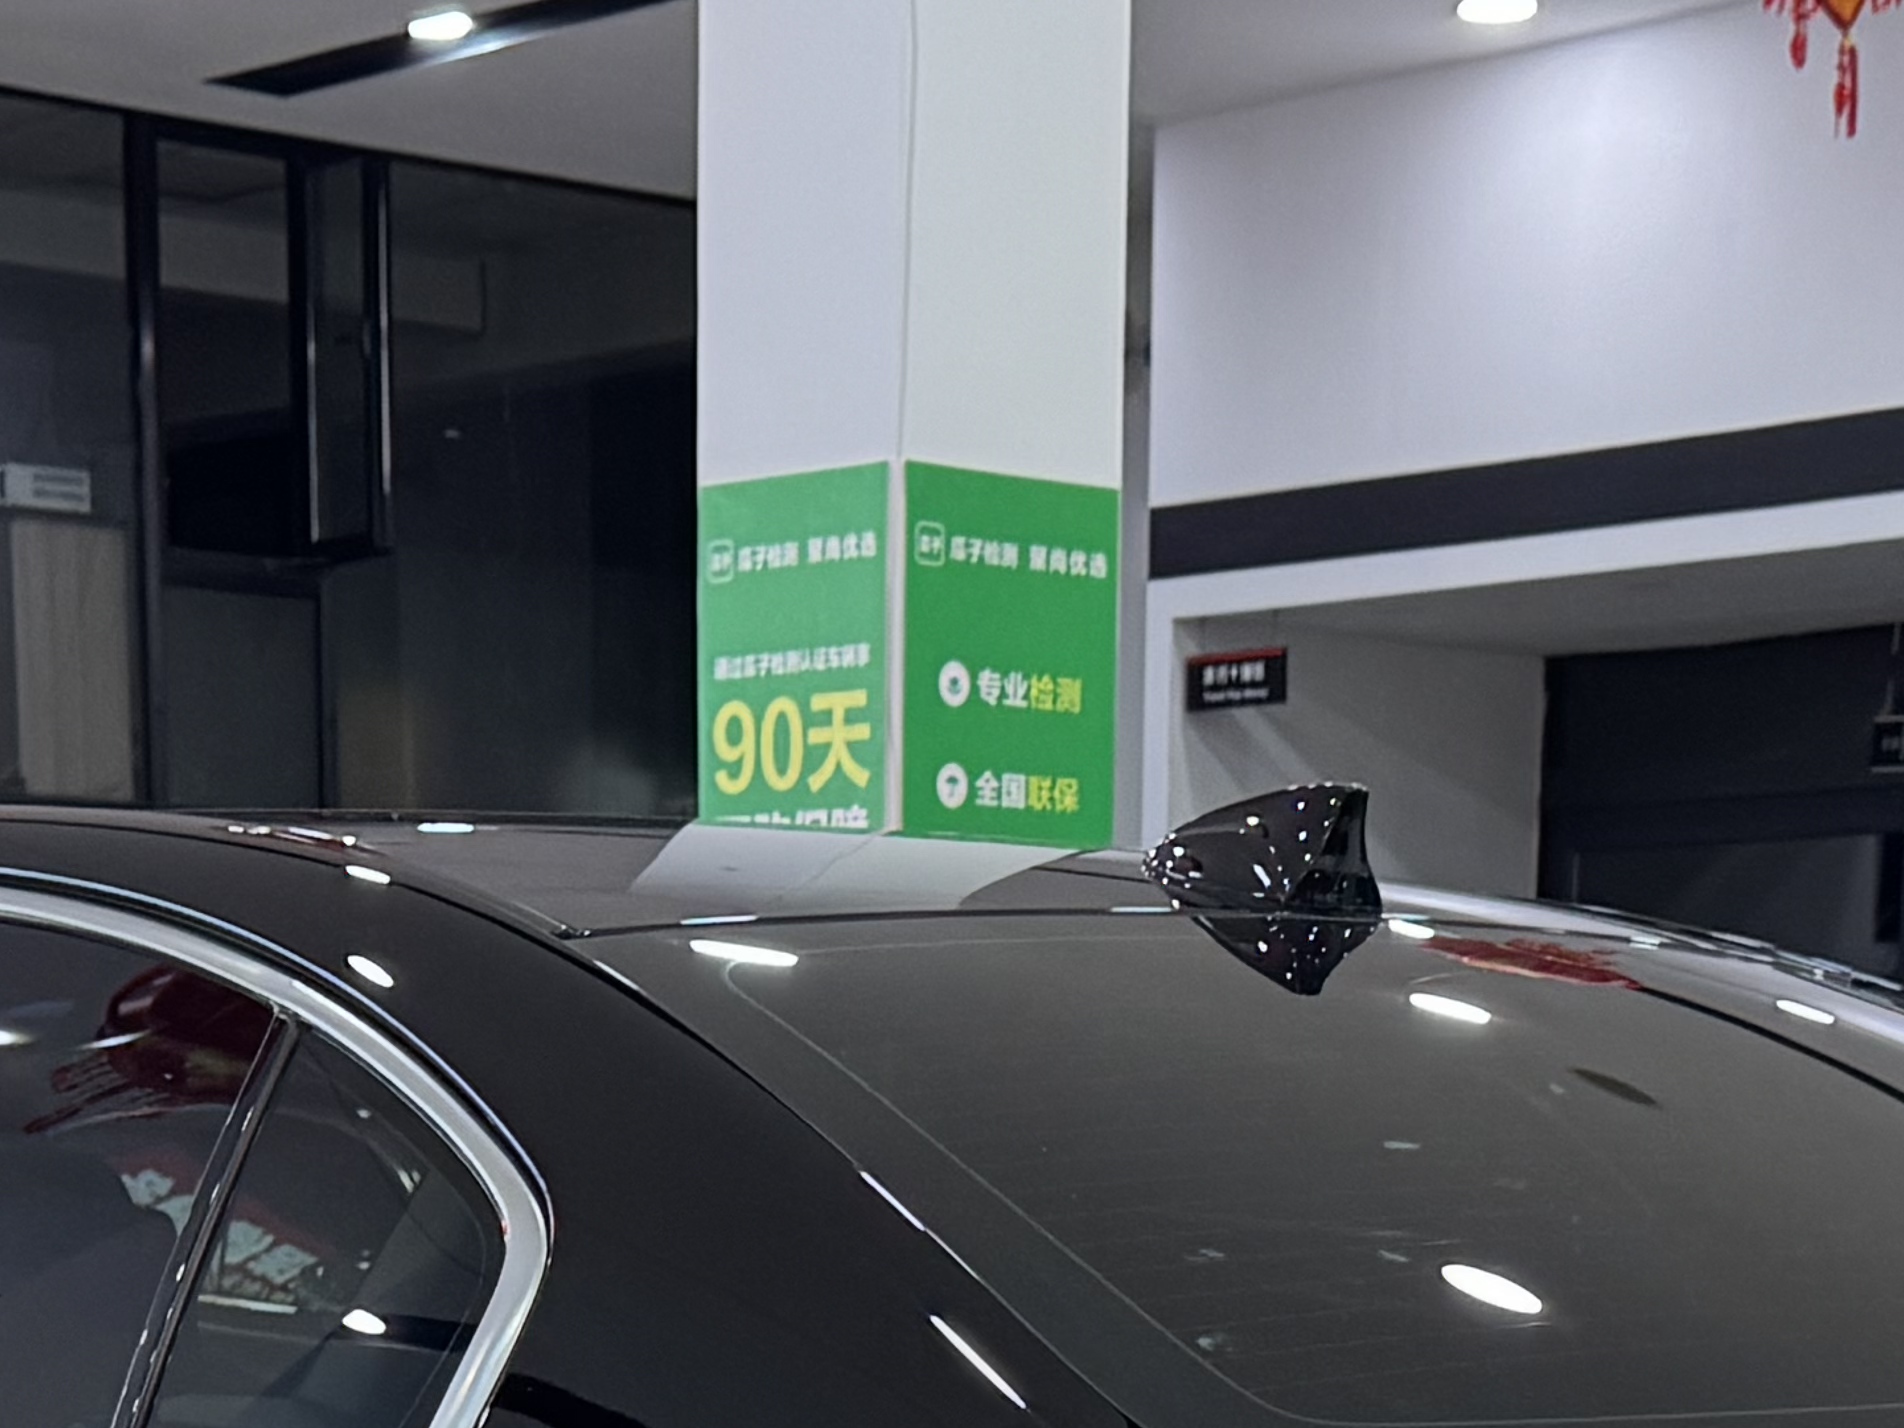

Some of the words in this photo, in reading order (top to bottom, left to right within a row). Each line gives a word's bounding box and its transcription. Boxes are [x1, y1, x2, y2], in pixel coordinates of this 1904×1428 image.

[977, 667, 1082, 714] 专业检测
[713, 688, 871, 795] 90天
[975, 770, 1080, 814] 全国联保
